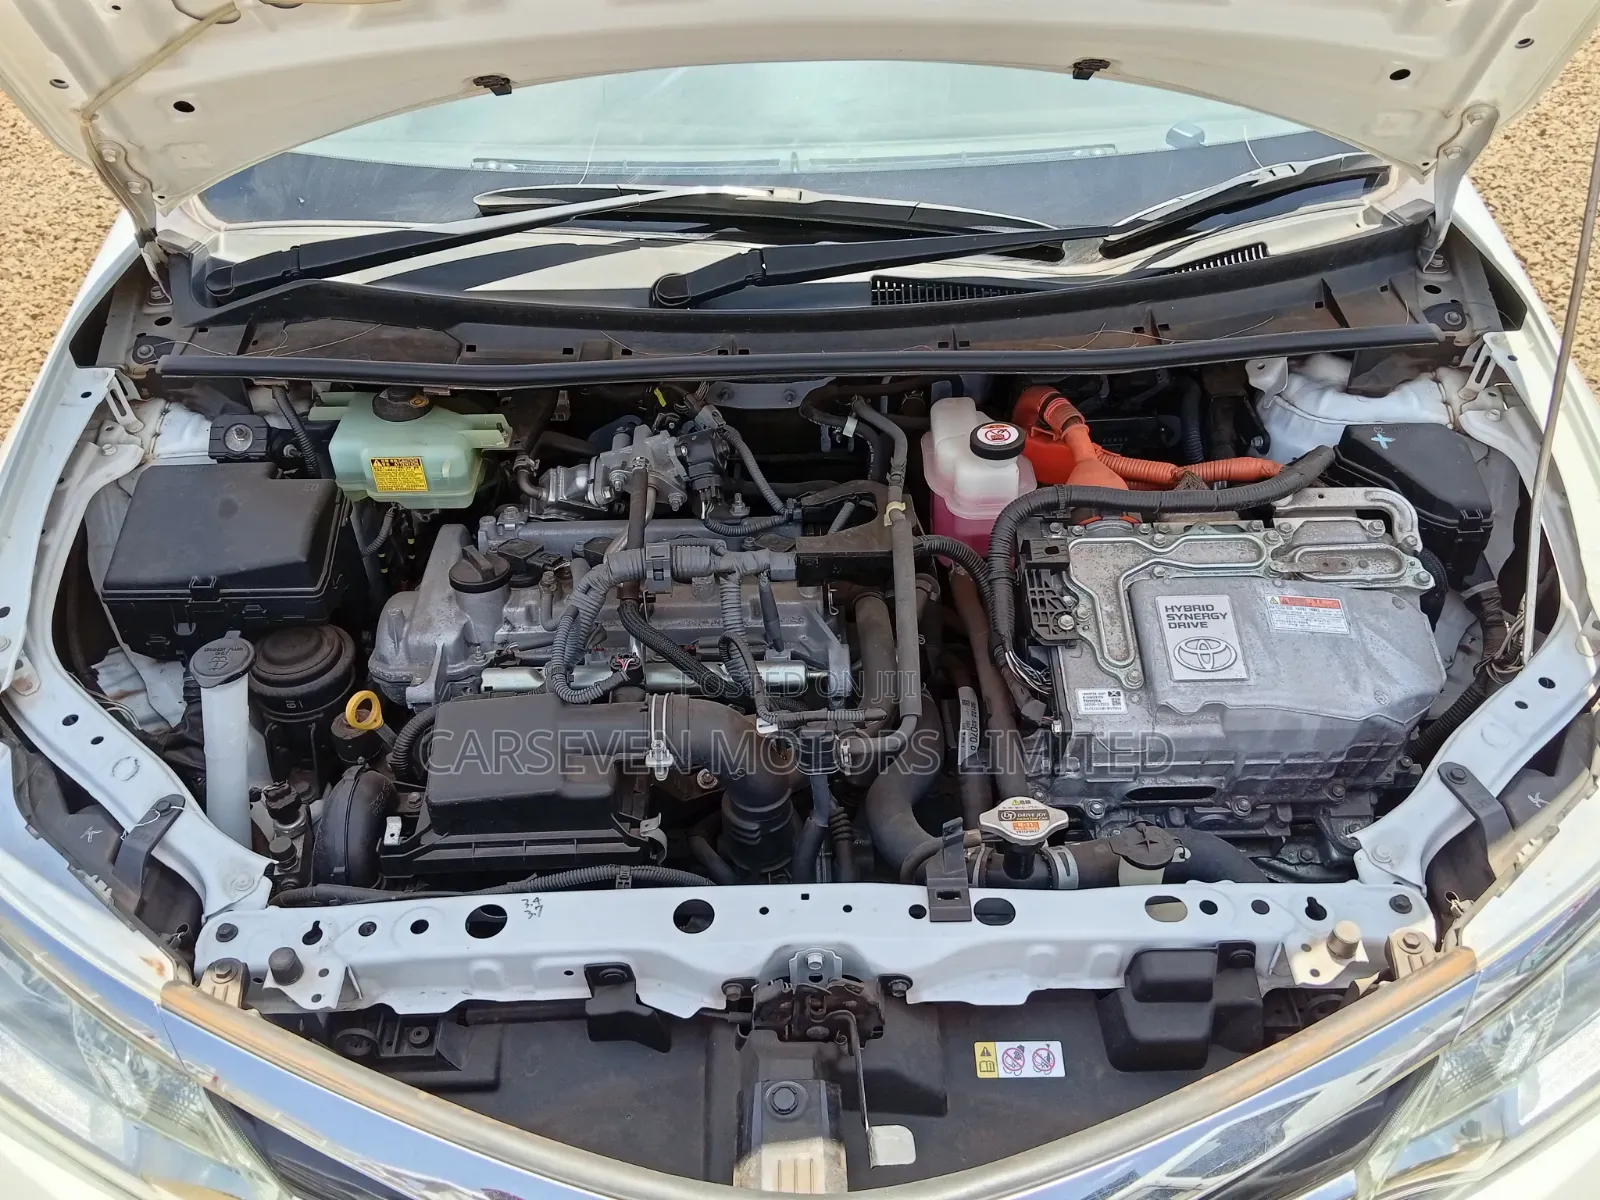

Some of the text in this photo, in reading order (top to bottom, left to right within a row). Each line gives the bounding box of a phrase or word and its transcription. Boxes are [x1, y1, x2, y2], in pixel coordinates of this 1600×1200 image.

[1164, 604, 1215, 612] HYBRID
[1166, 612, 1228, 621] SYNERGY
[1168, 621, 1209, 629] DRIVE
